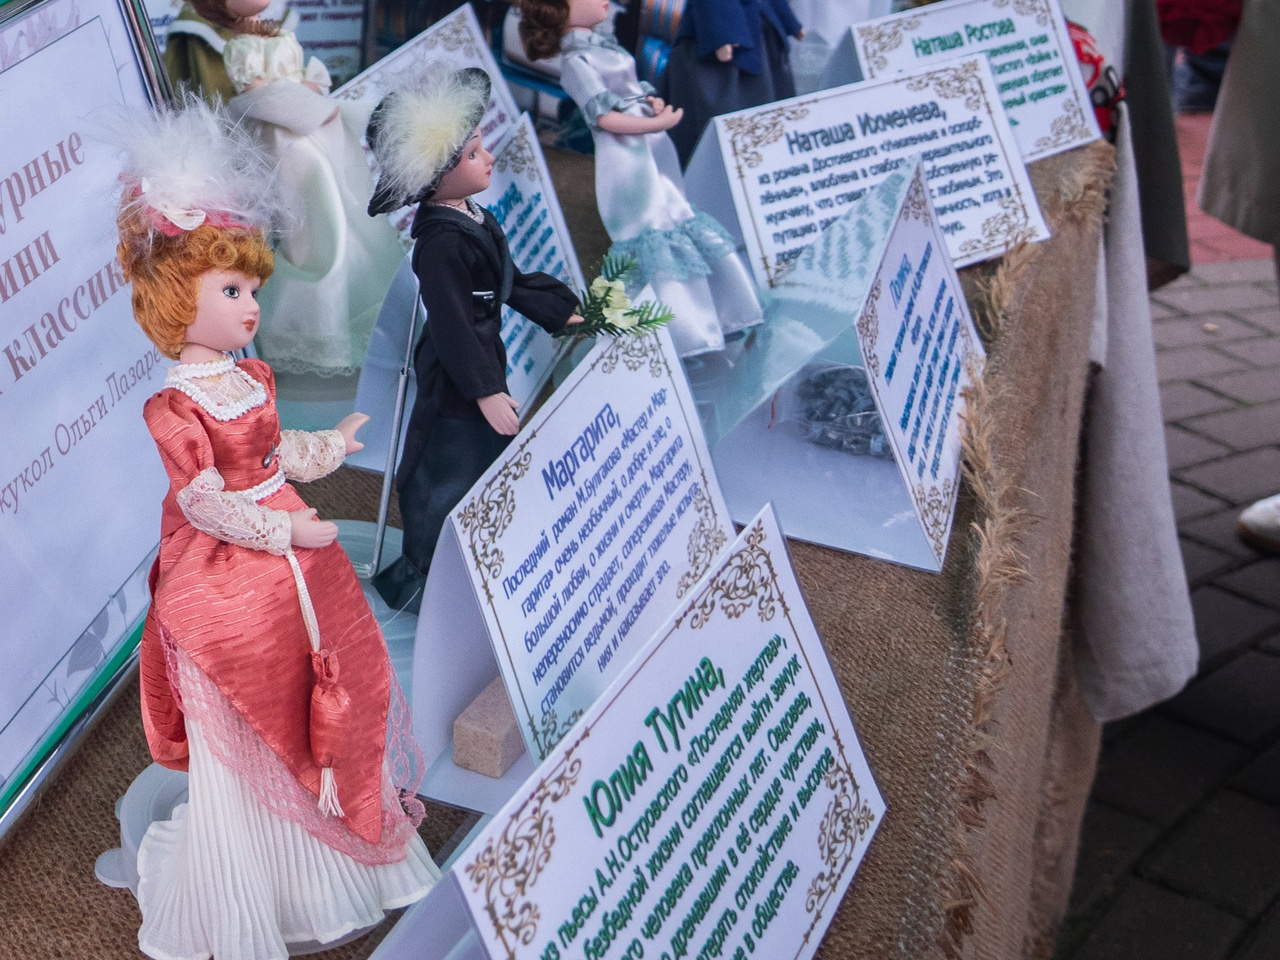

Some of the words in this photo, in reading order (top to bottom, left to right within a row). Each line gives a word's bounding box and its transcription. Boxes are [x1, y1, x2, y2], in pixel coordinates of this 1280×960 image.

[911, 30, 964, 57] Наташа
[963, 17, 1016, 43] Ростова
[784, 121, 856, 155] Наташа
[856, 100, 947, 137] Ихменева,
[2, 249, 130, 383] классик
[53, 393, 109, 456] Ольги
[104, 330, 164, 408] Лазаре
[501, 528, 551, 600] Последний
[550, 499, 578, 544] роман
[574, 445, 622, 508] М.Булгакова
[620, 411, 648, 450] «Мастер
[520, 568, 554, 618] гарита»
[553, 538, 579, 574] очень
[577, 478, 623, 544] необычный,
[625, 447, 648, 484] добре
[651, 424, 667, 448] зле,
[540, 402, 621, 501] Маргарита,
[523, 591, 562, 654] большой
[560, 562, 590, 606] любви,
[593, 520, 620, 559] жизни
[623, 480, 651, 519] смерти.
[647, 434, 683, 485] Маргарита
[531, 600, 589, 686] непереносимо
[587, 554, 623, 608] страдает,
[662, 458, 693, 501] Мастеру,
[596, 643, 613, 673] ния
[616, 576, 657, 642] наказывает
[539, 644, 585, 718] становится
[582, 597, 618, 654] ведьмой,
[615, 551, 648, 605] проходит
[556, 885, 599, 949] пьесы
[594, 762, 688, 896] А.Н.Островского
[686, 682, 746, 766] «Последняя
[741, 633, 787, 693] жертва»,
[581, 739, 654, 838] Юлия
[642, 655, 726, 753] Тугина,
[582, 865, 649, 960] безбедной
[644, 820, 684, 881] жизни
[680, 732, 745, 829] соглашается
[740, 692, 774, 743] выйти
[769, 652, 802, 702] замуж
[639, 861, 694, 940] человека
[689, 773, 752, 870] преклонных
[747, 747, 771, 784] лет.
[766, 690, 812, 752] Овдовев,
[733, 813, 793, 911] спокойствие
[795, 745, 835, 810] высокое
[669, 858, 731, 960] дремавшим
[747, 776, 784, 834] сердце
[779, 716, 825, 782] чувствам,
[750, 859, 800, 939] обществе.
